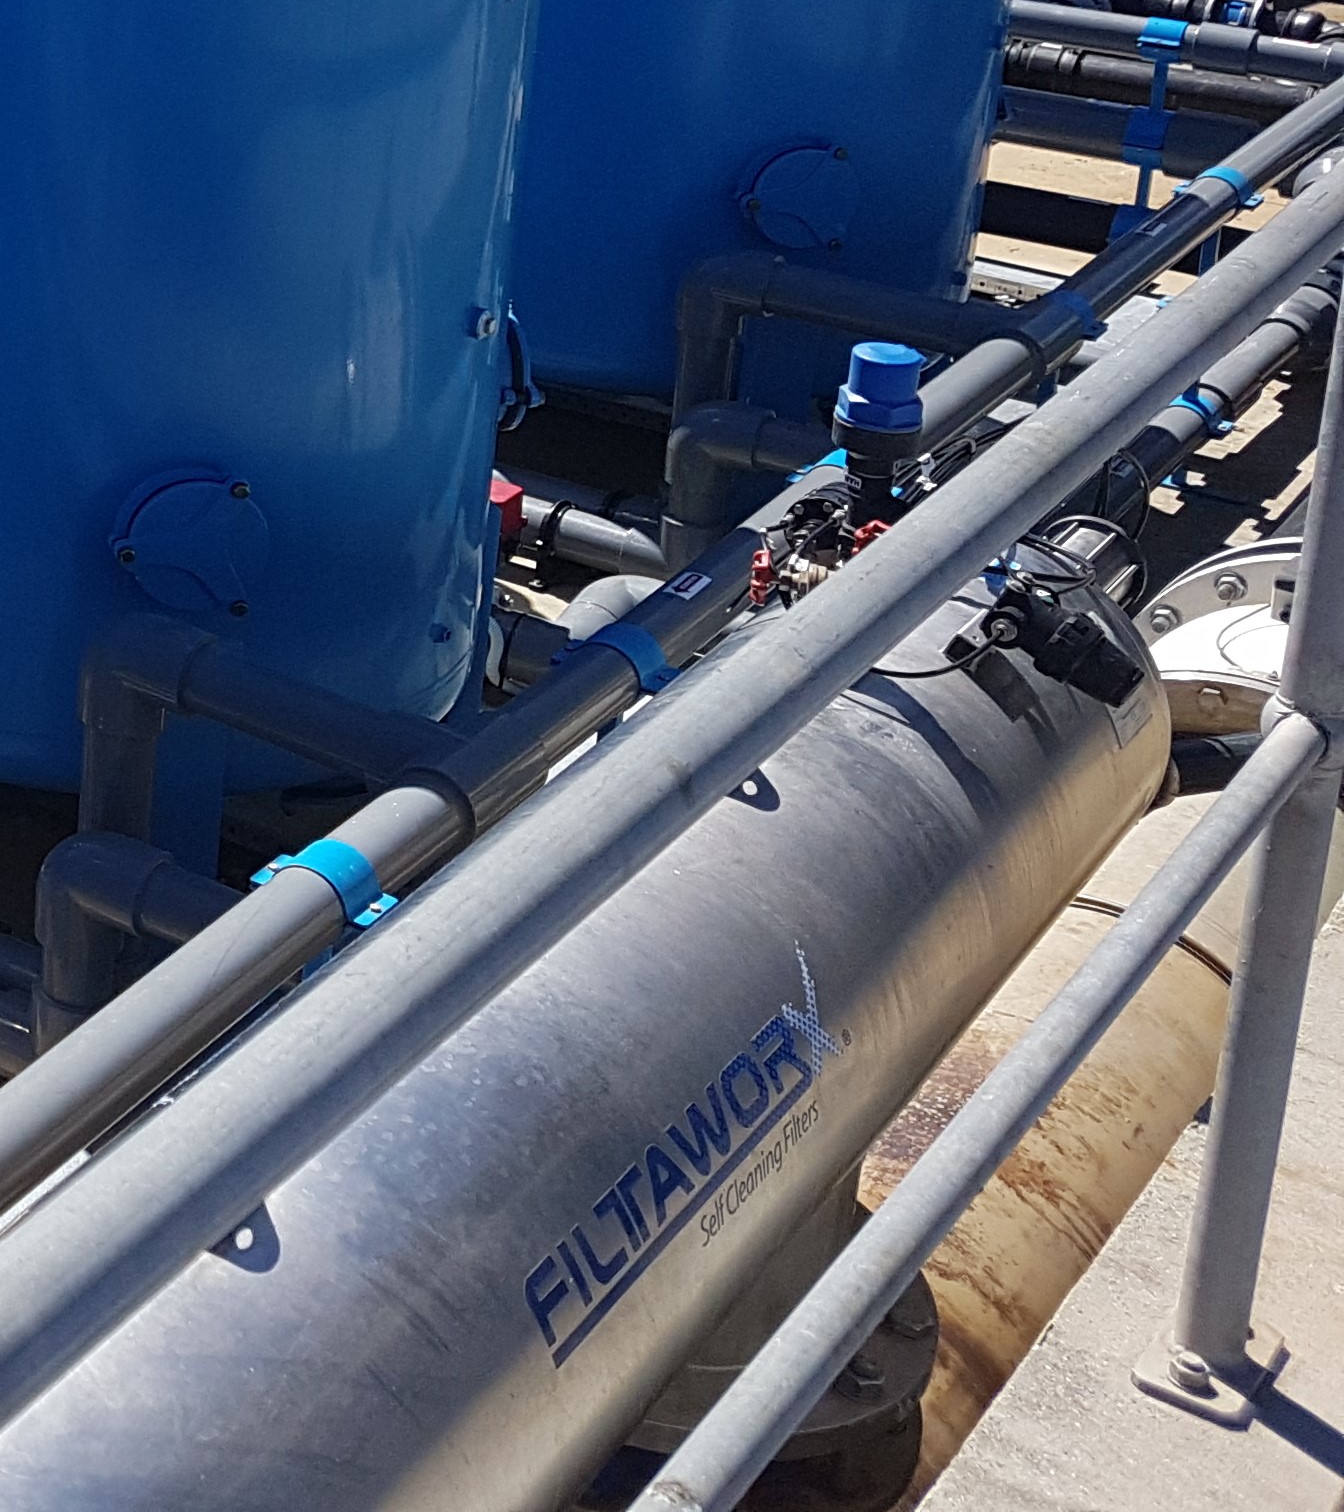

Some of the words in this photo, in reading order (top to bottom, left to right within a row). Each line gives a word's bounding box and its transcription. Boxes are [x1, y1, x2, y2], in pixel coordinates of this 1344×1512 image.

[522, 938, 844, 1349] FILTAWORX
[700, 1193, 725, 1247] Self
[726, 1140, 783, 1215] Cleaning
[782, 1100, 819, 1154] Filters
